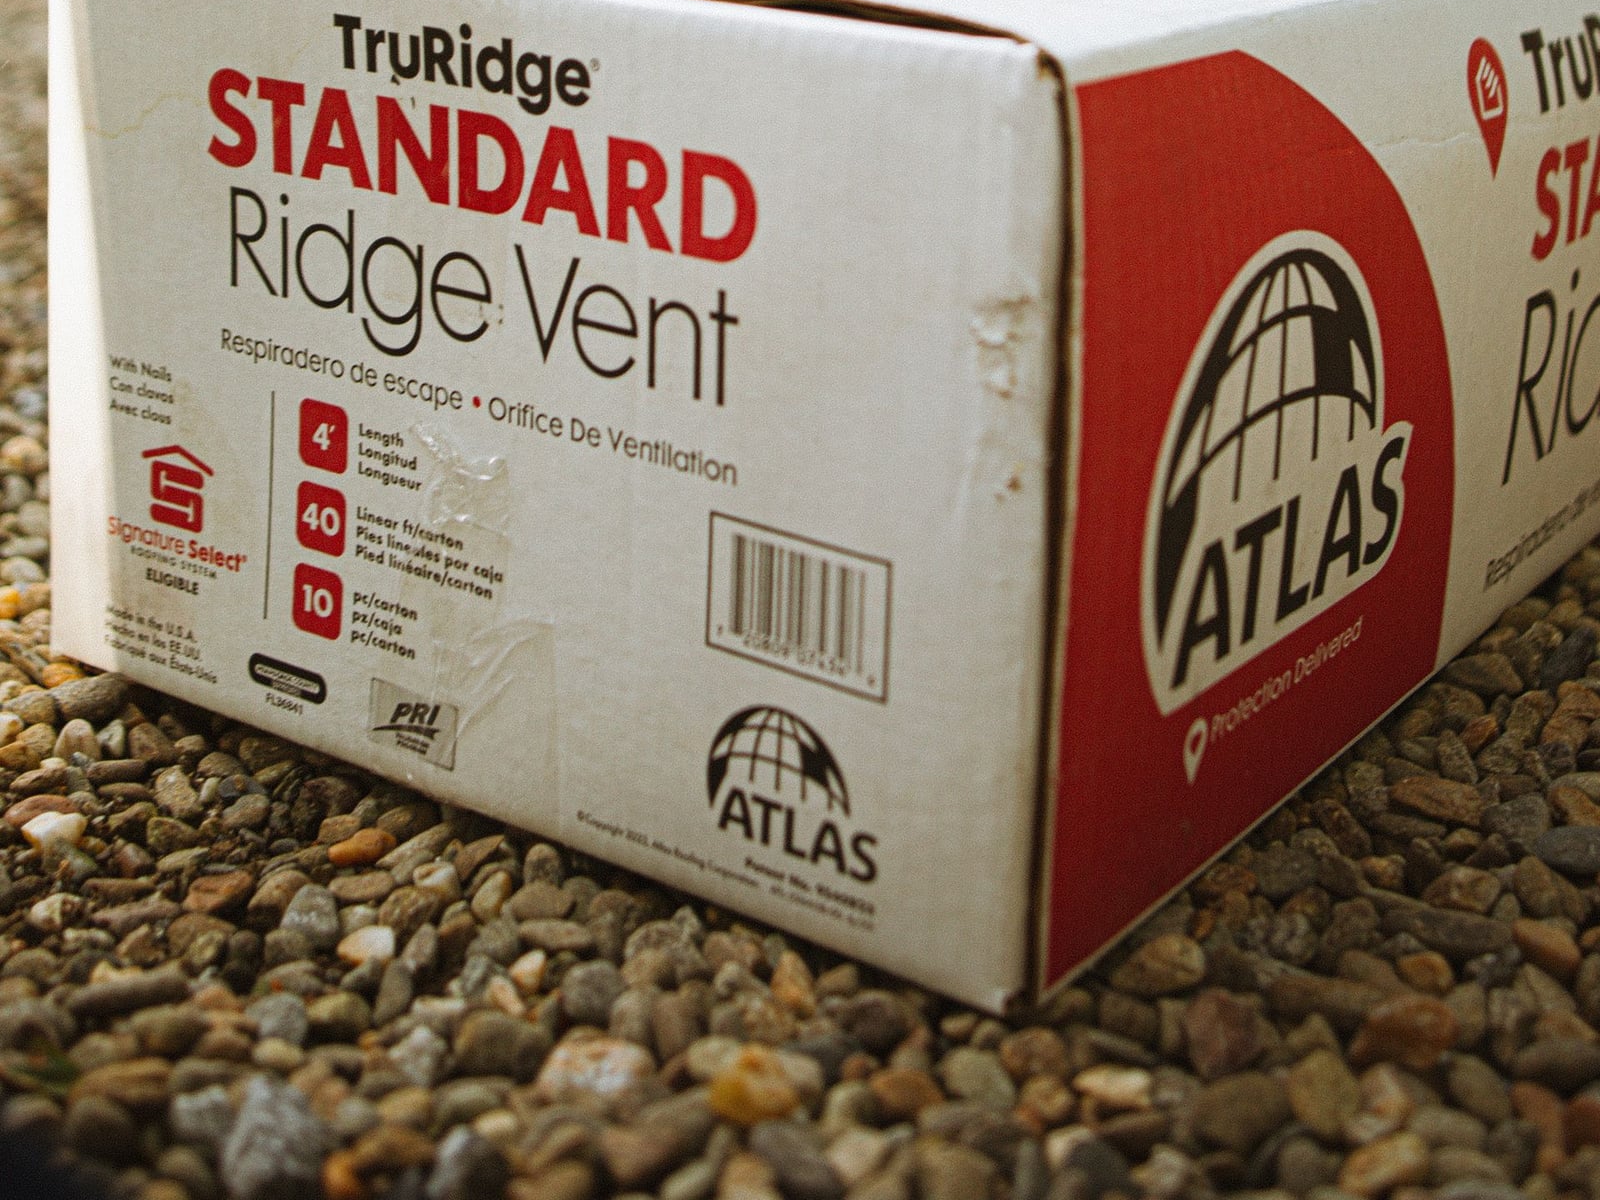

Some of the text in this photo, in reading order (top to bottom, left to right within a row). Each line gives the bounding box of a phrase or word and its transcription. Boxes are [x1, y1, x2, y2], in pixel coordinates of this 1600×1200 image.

[207, 67, 758, 263] STANDARD
[229, 185, 739, 405] Ridge Vent
[220, 327, 739, 487] Respiradero de escape Orifice De Ventilation
[358, 422, 405, 450] Length
[357, 442, 418, 471] Longitud
[357, 461, 423, 491] Longueur
[301, 502, 341, 537] 40
[356, 505, 464, 551] Linear ft/carton
[107, 515, 243, 573] Signature Select
[354, 544, 385, 566] Pied
[355, 525, 384, 547] Pies
[443, 554, 469, 574] por
[473, 560, 504, 585] caja
[1168, 436, 1406, 689] ATLAS
[145, 567, 200, 596] ELIGIBLE
[302, 584, 334, 618] 10
[352, 589, 419, 622] pc/carton
[351, 609, 403, 637] pz/caja
[350, 627, 417, 661] pc/carton
[1293, 615, 1364, 683] Delivered
[390, 702, 441, 726] PRI
[717, 786, 879, 883] ATLAS
